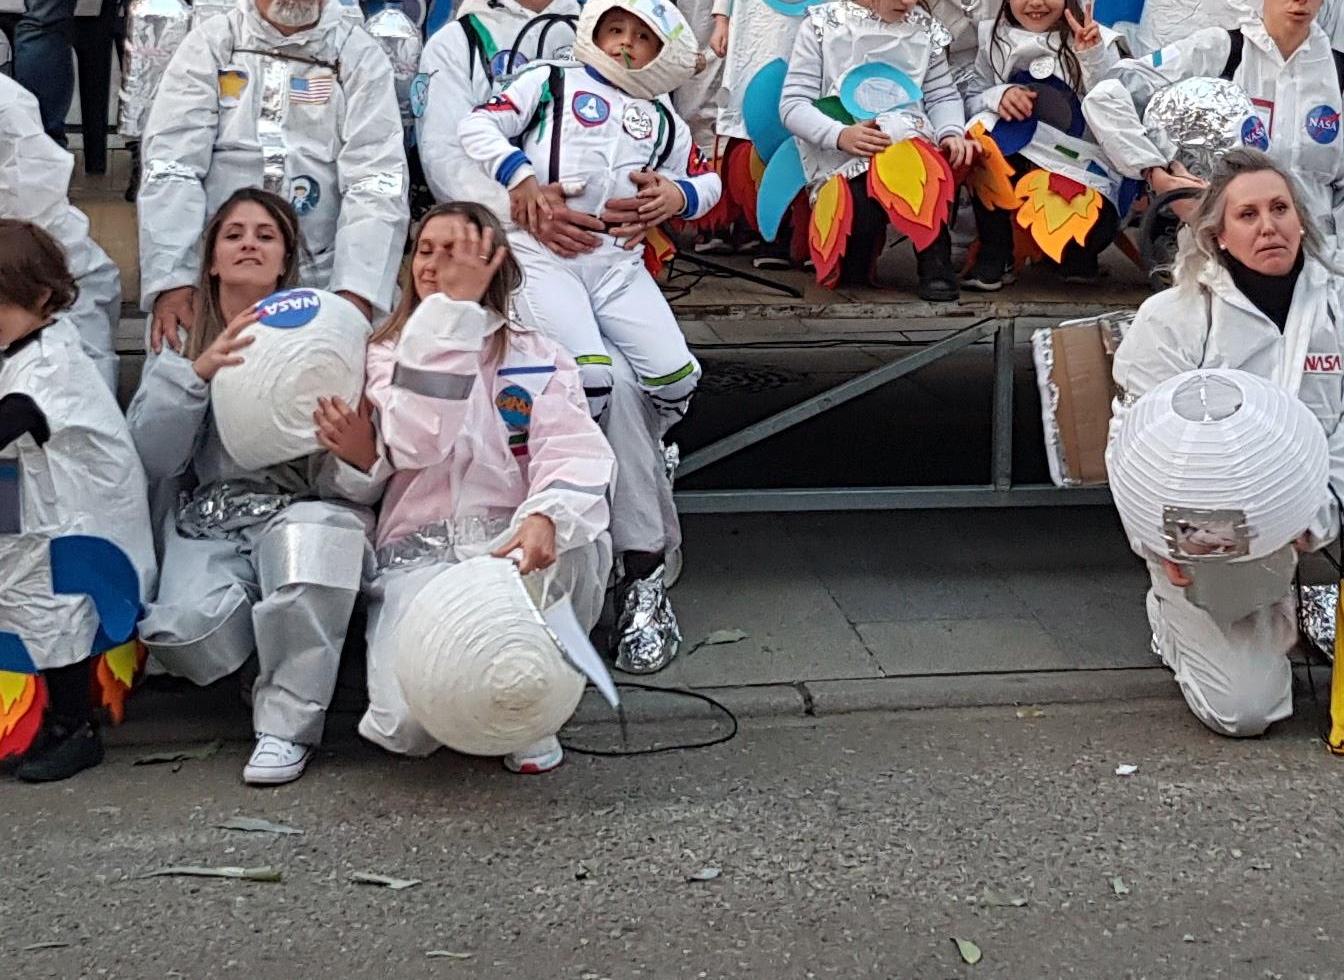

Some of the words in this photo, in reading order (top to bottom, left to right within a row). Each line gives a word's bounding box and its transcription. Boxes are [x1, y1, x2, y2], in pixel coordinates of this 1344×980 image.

[1309, 117, 1337, 132] NASA
[264, 295, 319, 317] NASA
[1303, 355, 1342, 371] NASA
